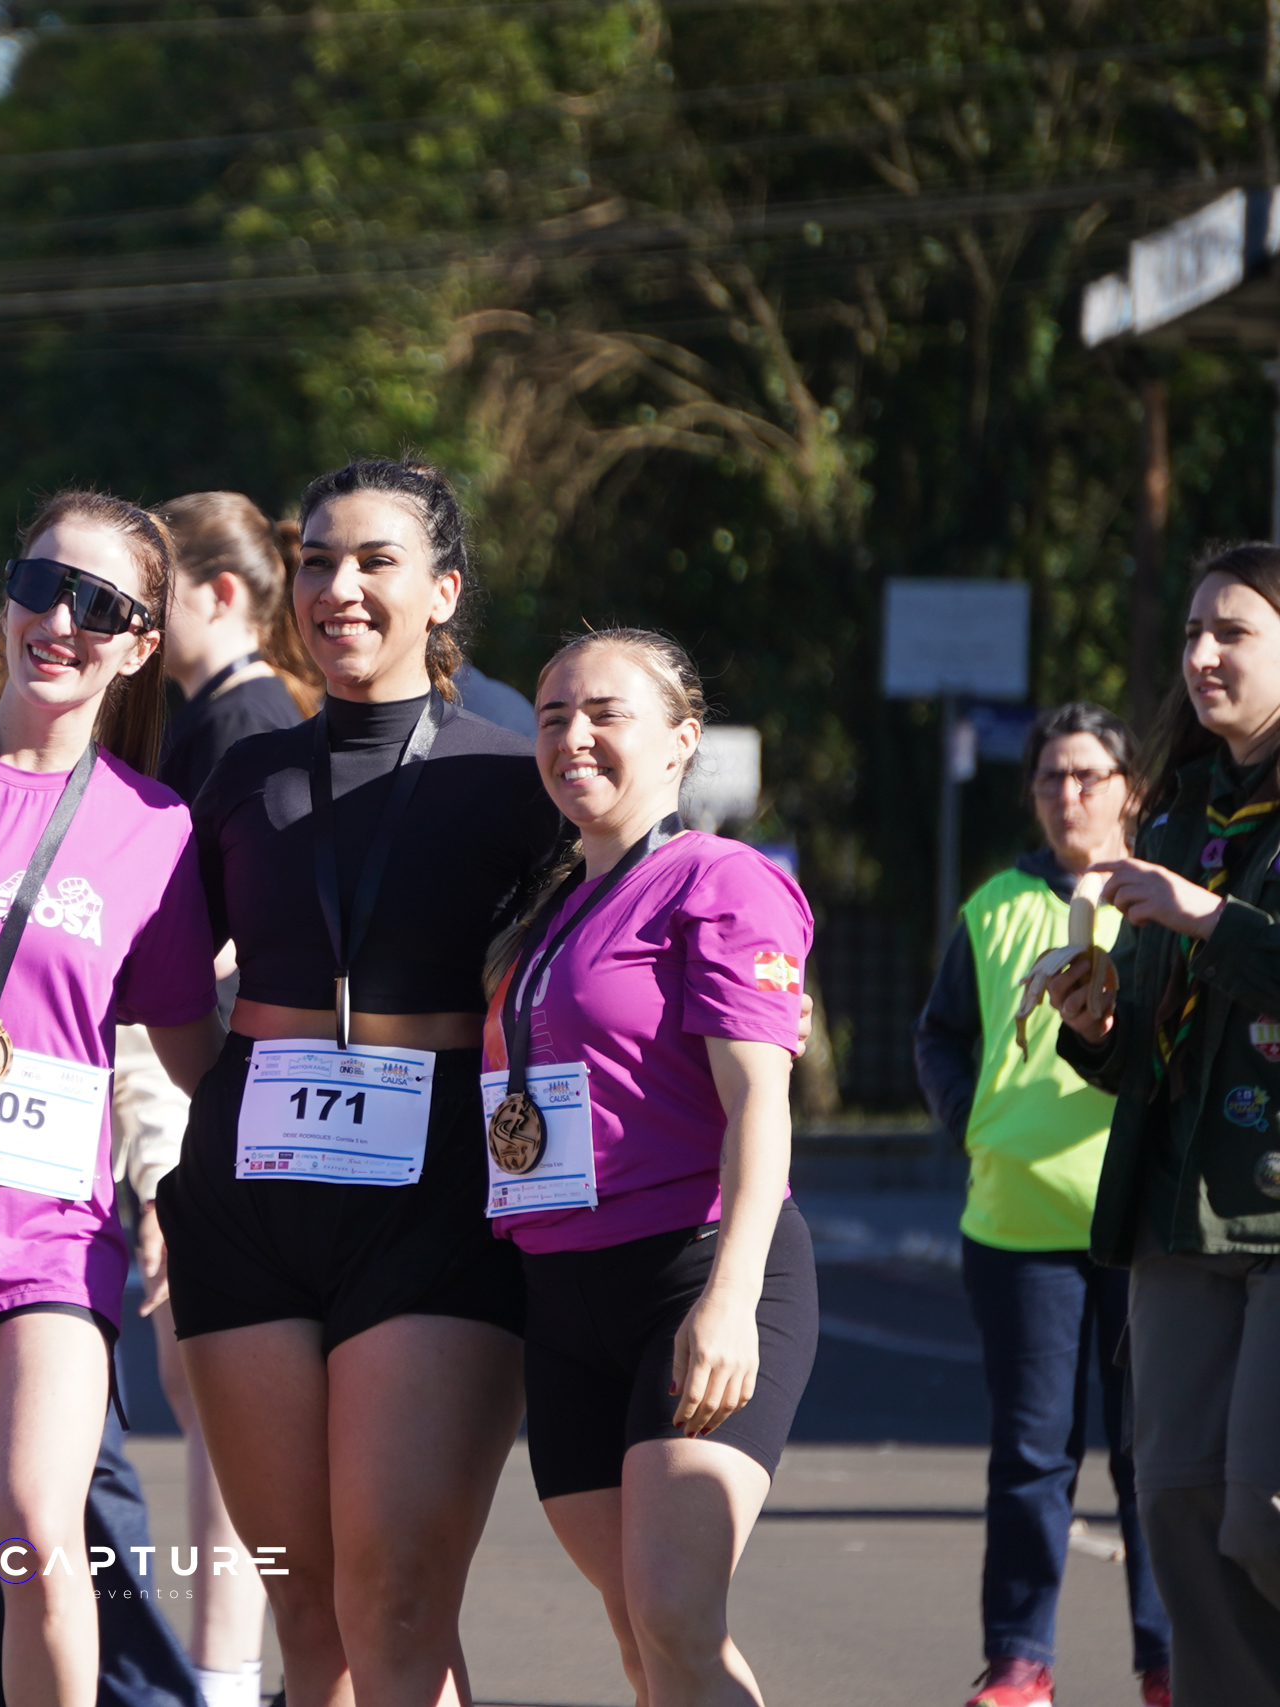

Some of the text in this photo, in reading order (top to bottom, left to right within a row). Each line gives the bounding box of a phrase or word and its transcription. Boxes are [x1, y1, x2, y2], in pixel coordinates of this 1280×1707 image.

[381, 1076, 408, 1086] CAUSA
[549, 1095, 571, 1104] CAUSA
[290, 1087, 366, 1125] 171
[299, 1132, 331, 1141] RODRIGUES
[335, 1136, 355, 1144] Corrida
